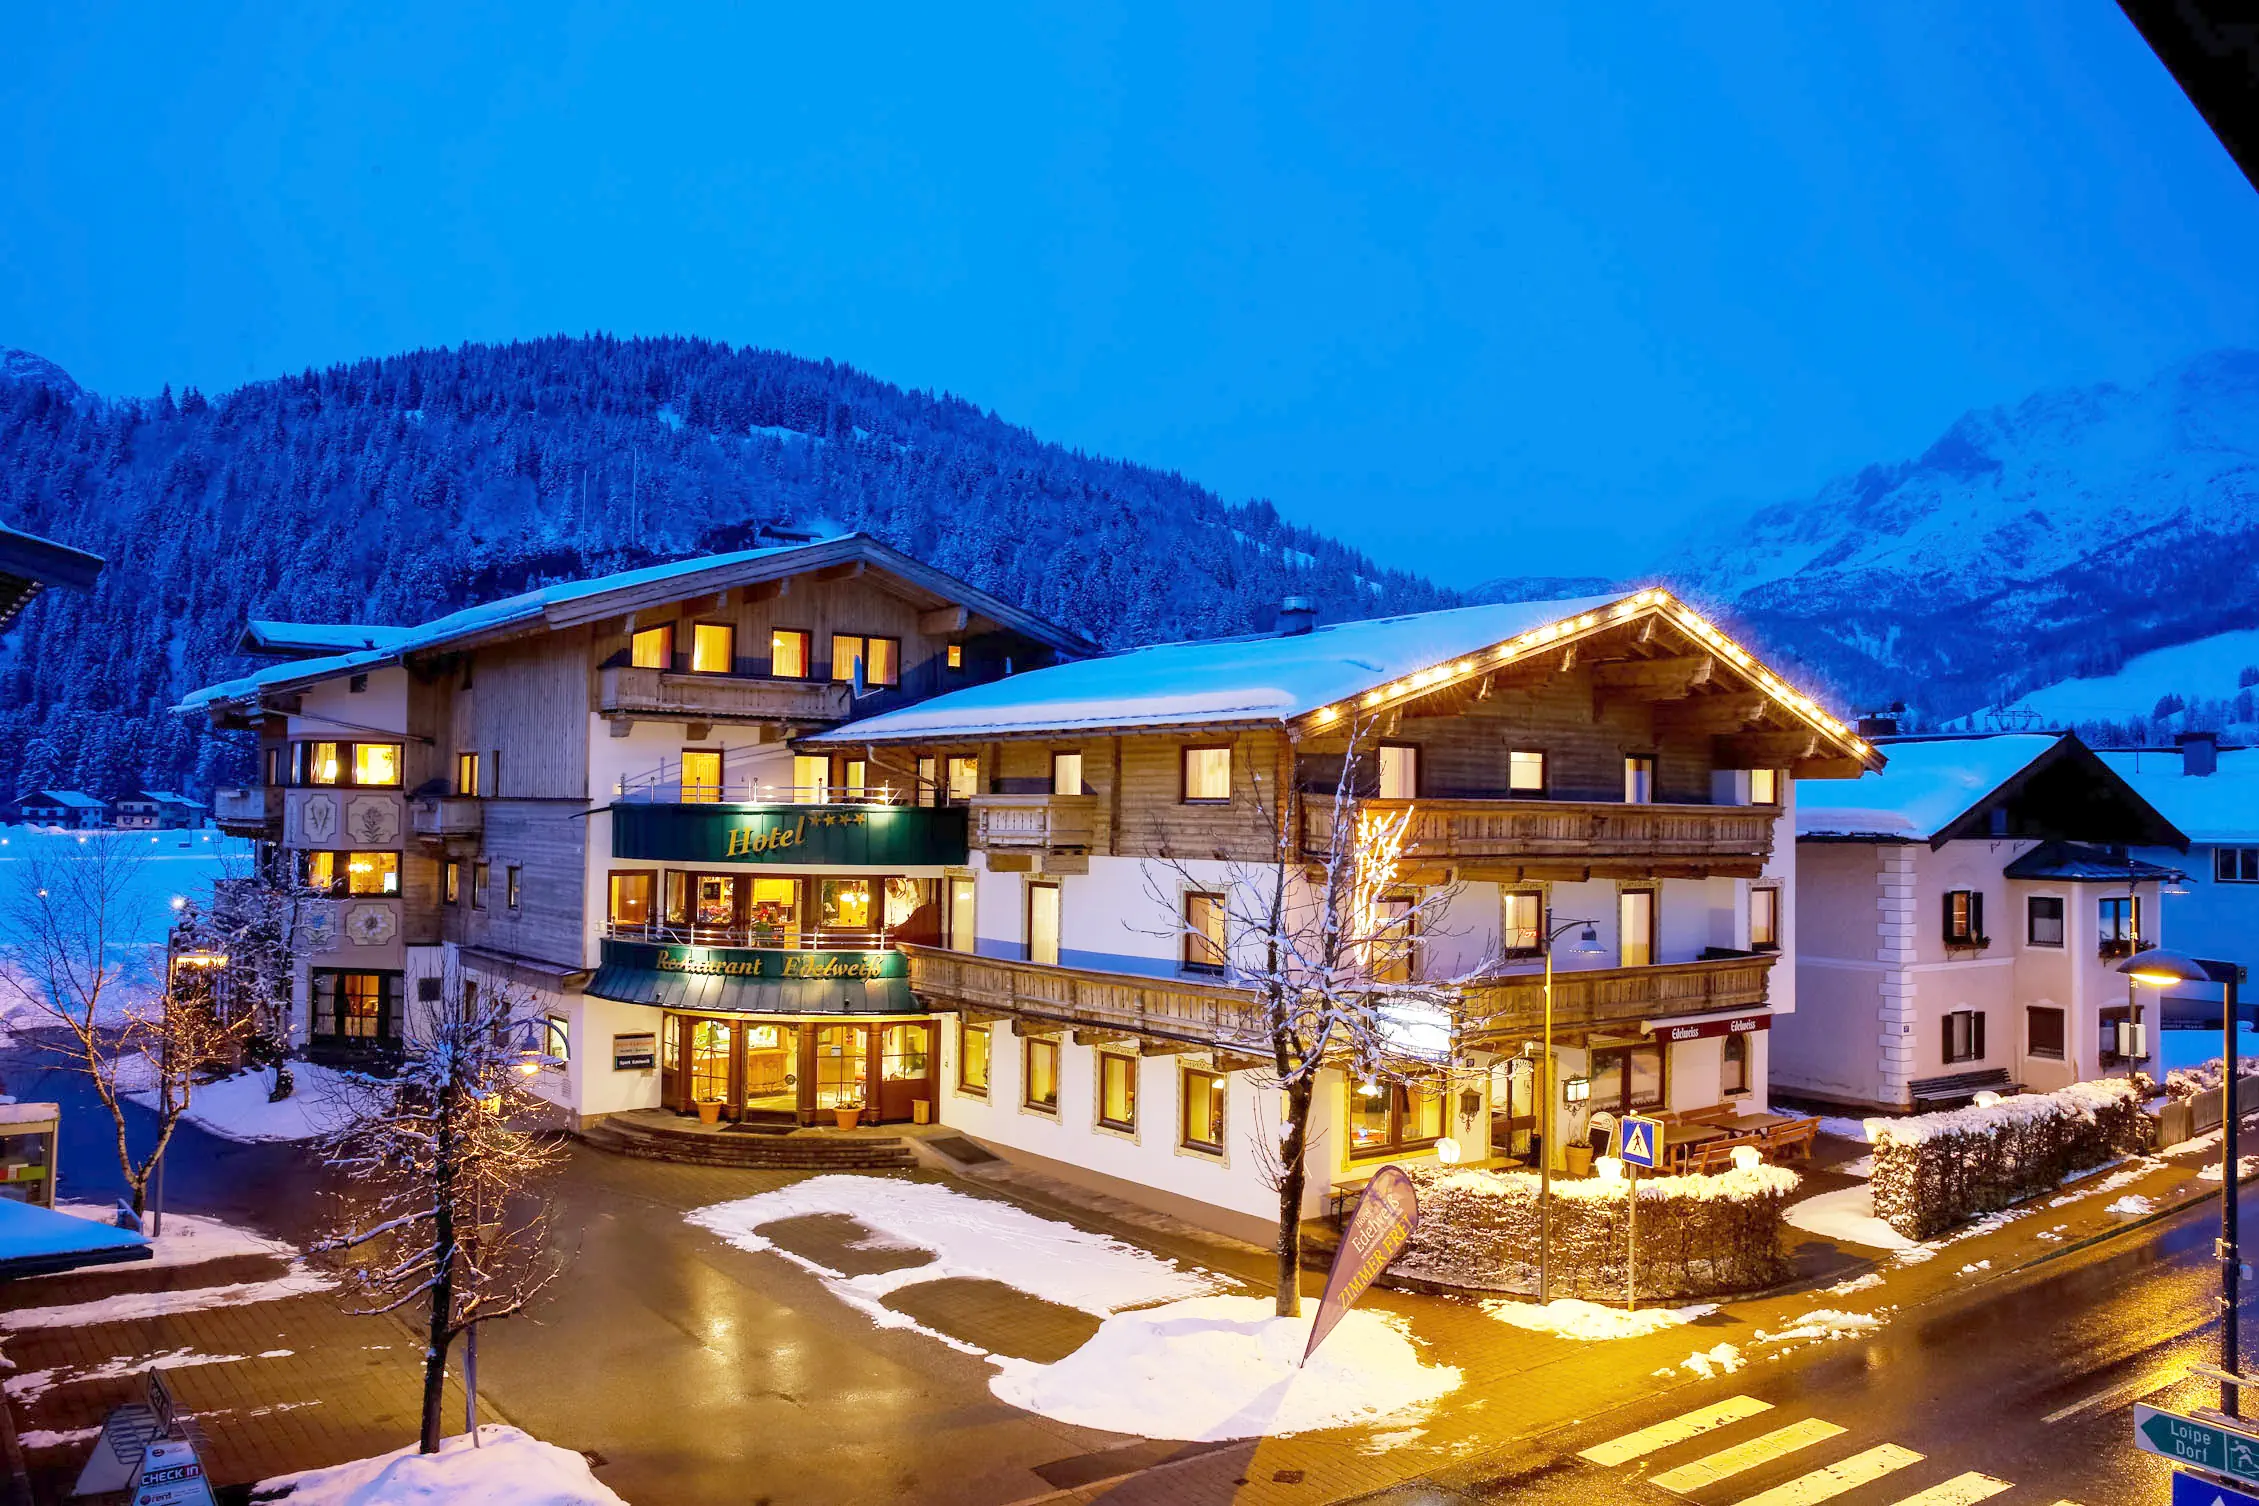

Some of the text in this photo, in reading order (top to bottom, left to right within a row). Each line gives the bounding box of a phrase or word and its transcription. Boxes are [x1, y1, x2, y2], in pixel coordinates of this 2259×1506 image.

[726, 815, 806, 857] Hotel
[656, 950, 762, 976] Restaurant
[1672, 1019, 1756, 1040] Edelweiss Edelweiss
[1355, 1207, 1372, 1229] Hotel
[1338, 1249, 1388, 1311] ZIMMER
[1382, 1214, 1414, 1256] FREI
[2170, 1420, 2212, 1446] Loipe
[2176, 1439, 2207, 1463] Dorf
[141, 1467, 184, 1486] CHECK
